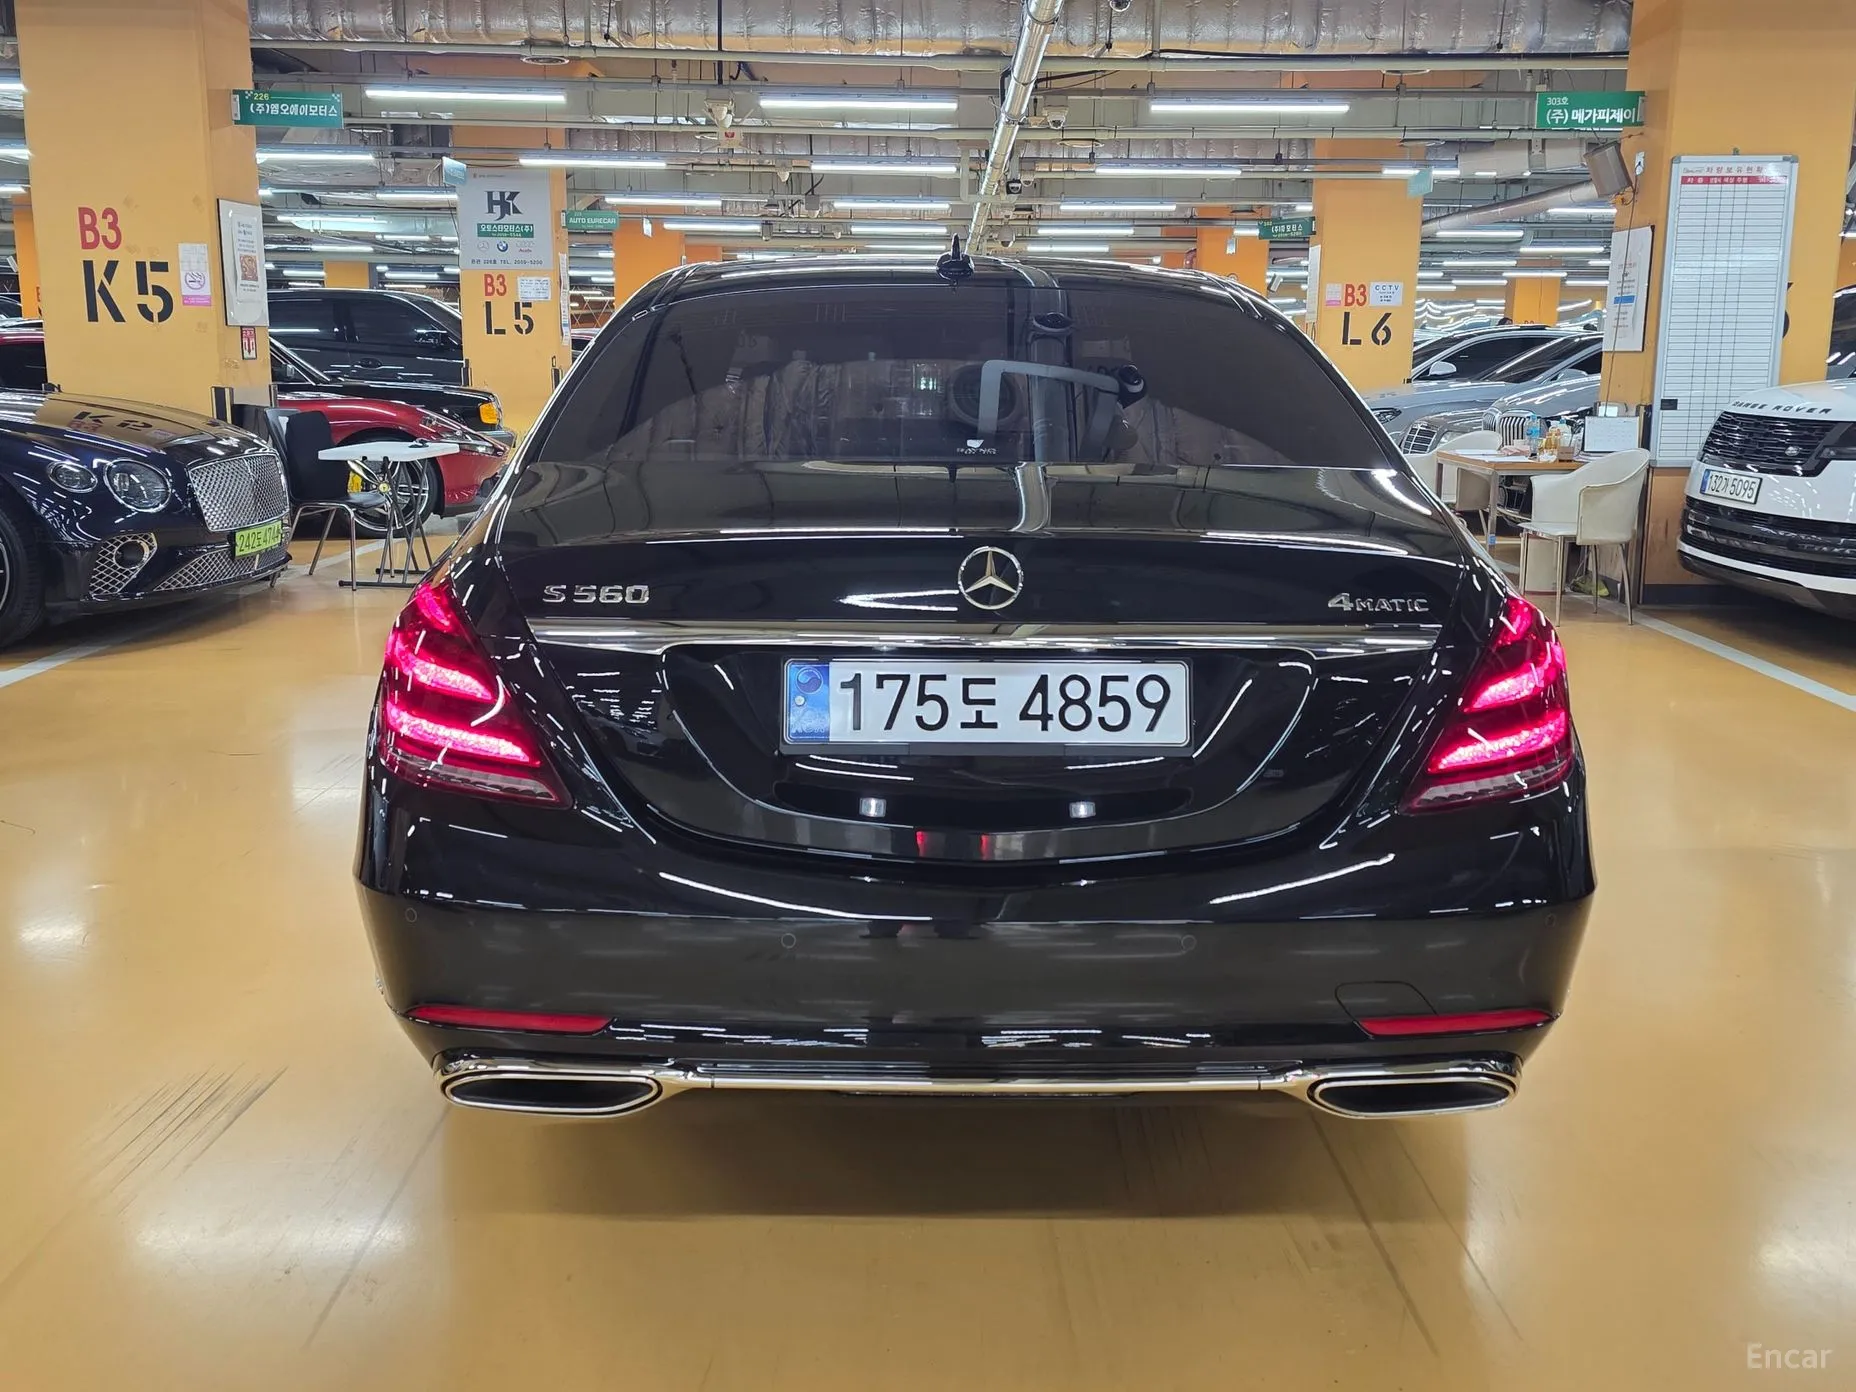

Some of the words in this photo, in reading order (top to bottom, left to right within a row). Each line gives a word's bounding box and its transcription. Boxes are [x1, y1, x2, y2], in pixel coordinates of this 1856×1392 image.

[253, 92, 270, 101] 226
[1546, 97, 1569, 106] 303호
[1546, 108, 1569, 125] (주)
[78, 206, 122, 250] B3
[484, 274, 507, 296] B3
[1344, 284, 1367, 306] B3
[1732, 401, 1768, 410] RANGE
[1772, 405, 1833, 415] ROVER
[1730, 478, 1756, 499] 5095
[542, 585, 567, 603] S
[573, 585, 650, 603] 560
[1327, 592, 1429, 612] 4MATIC
[840, 673, 998, 731] 175도
[1019, 674, 1171, 732] 4859
